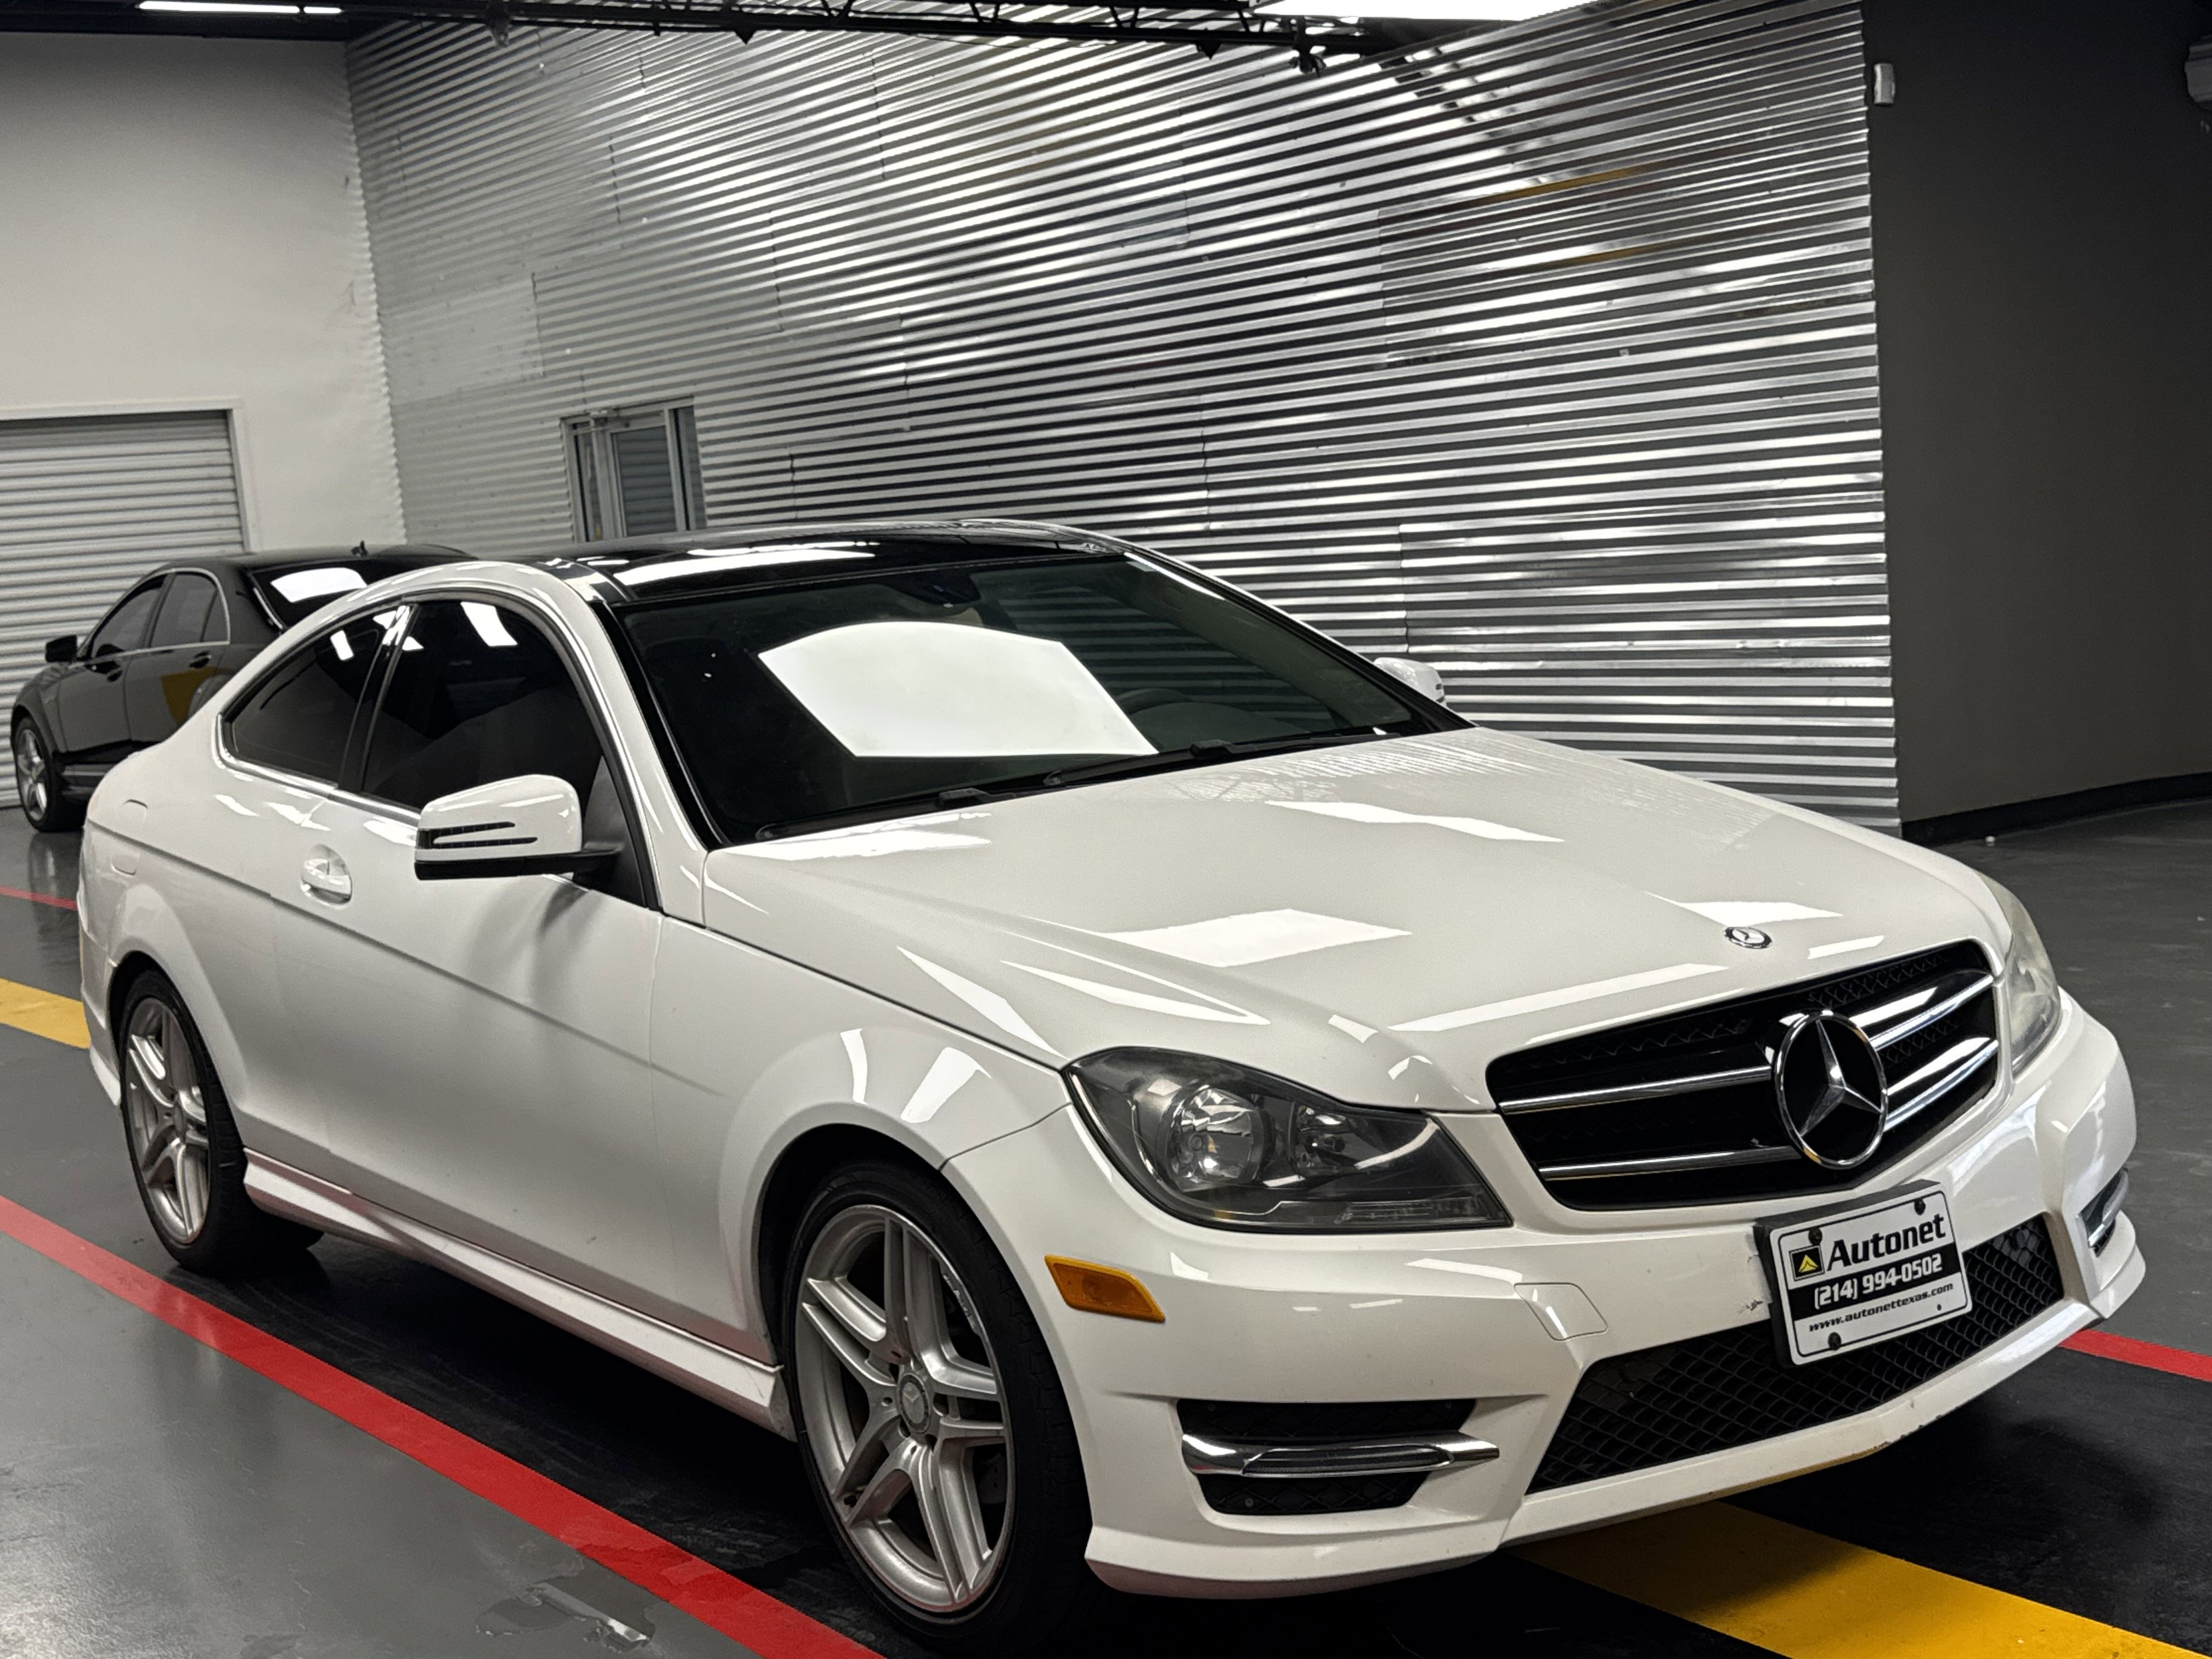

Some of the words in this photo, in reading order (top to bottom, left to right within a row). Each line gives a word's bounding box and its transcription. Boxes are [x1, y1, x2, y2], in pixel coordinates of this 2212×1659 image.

[1827, 1214, 1946, 1271] Autonet
[1809, 1283, 1954, 1332] www.autonettexas.com
[1814, 1278, 1858, 1309] (214)
[1862, 1253, 1943, 1294] 994-0502
